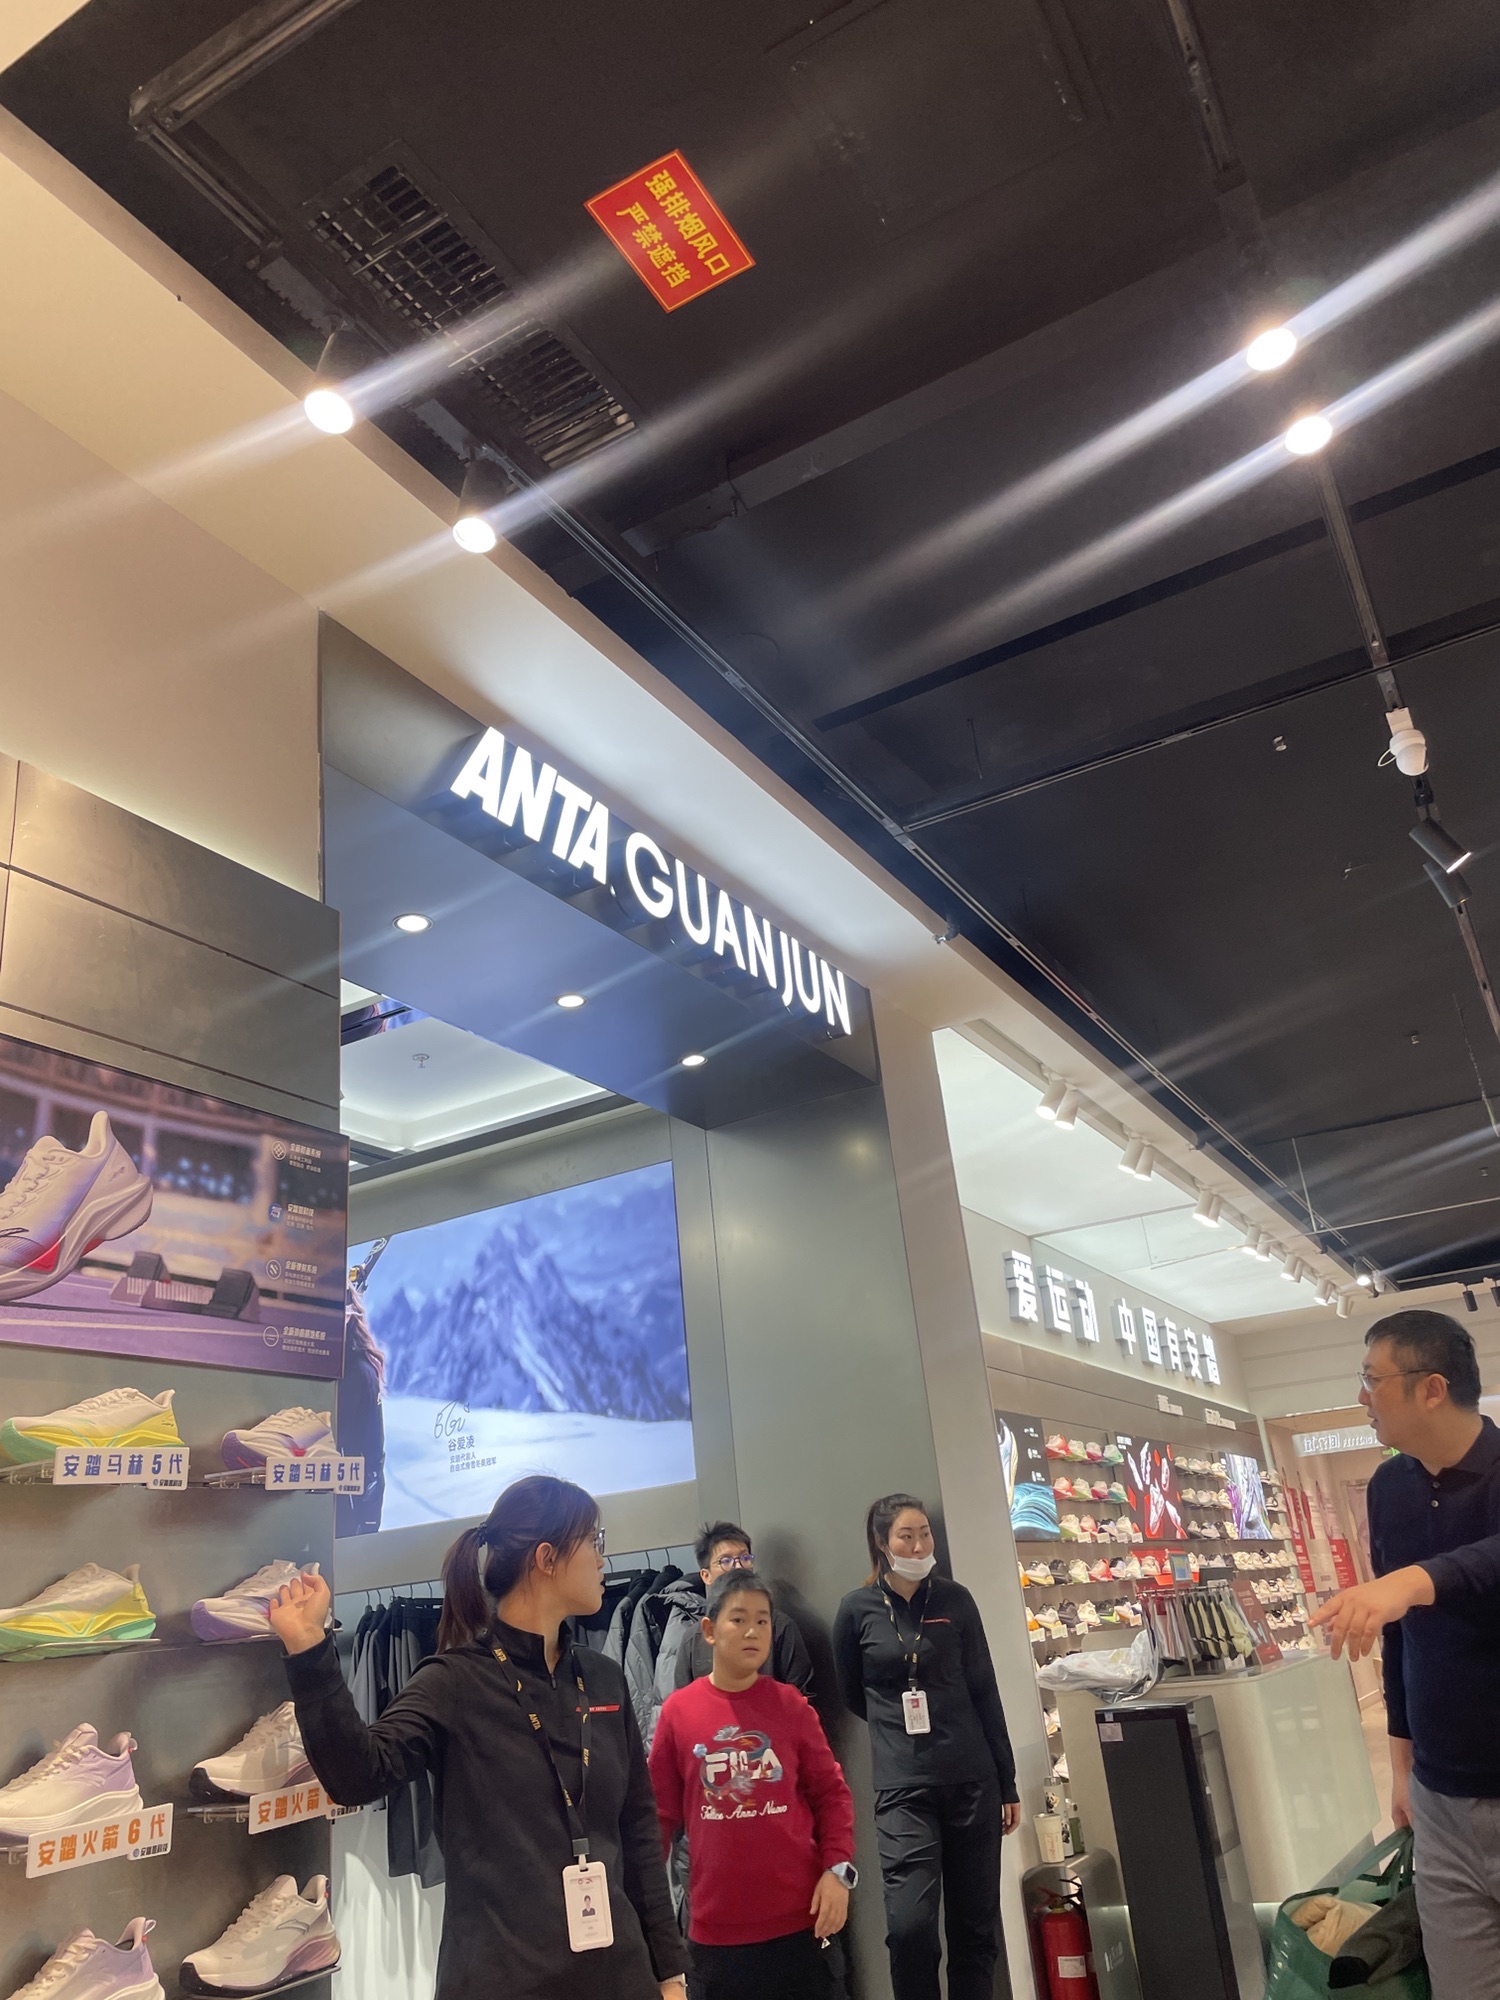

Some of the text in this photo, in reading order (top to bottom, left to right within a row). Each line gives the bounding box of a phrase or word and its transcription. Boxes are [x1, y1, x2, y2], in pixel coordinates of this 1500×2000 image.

[616, 202, 691, 288] 严禁遮挡
[644, 169, 730, 276] 强排烟风口
[450, 726, 852, 1035] ANTA GUANJUN
[1009, 1250, 1100, 1343] 爱运动
[63, 1453, 183, 1477] 安踏马赫5代
[448, 1435, 475, 1452] 谷爱凌
[272, 1462, 360, 1483] 安踏马赫5代
[705, 1748, 782, 1783] FILA
[37, 1812, 166, 1869] 安踏火箭6代
